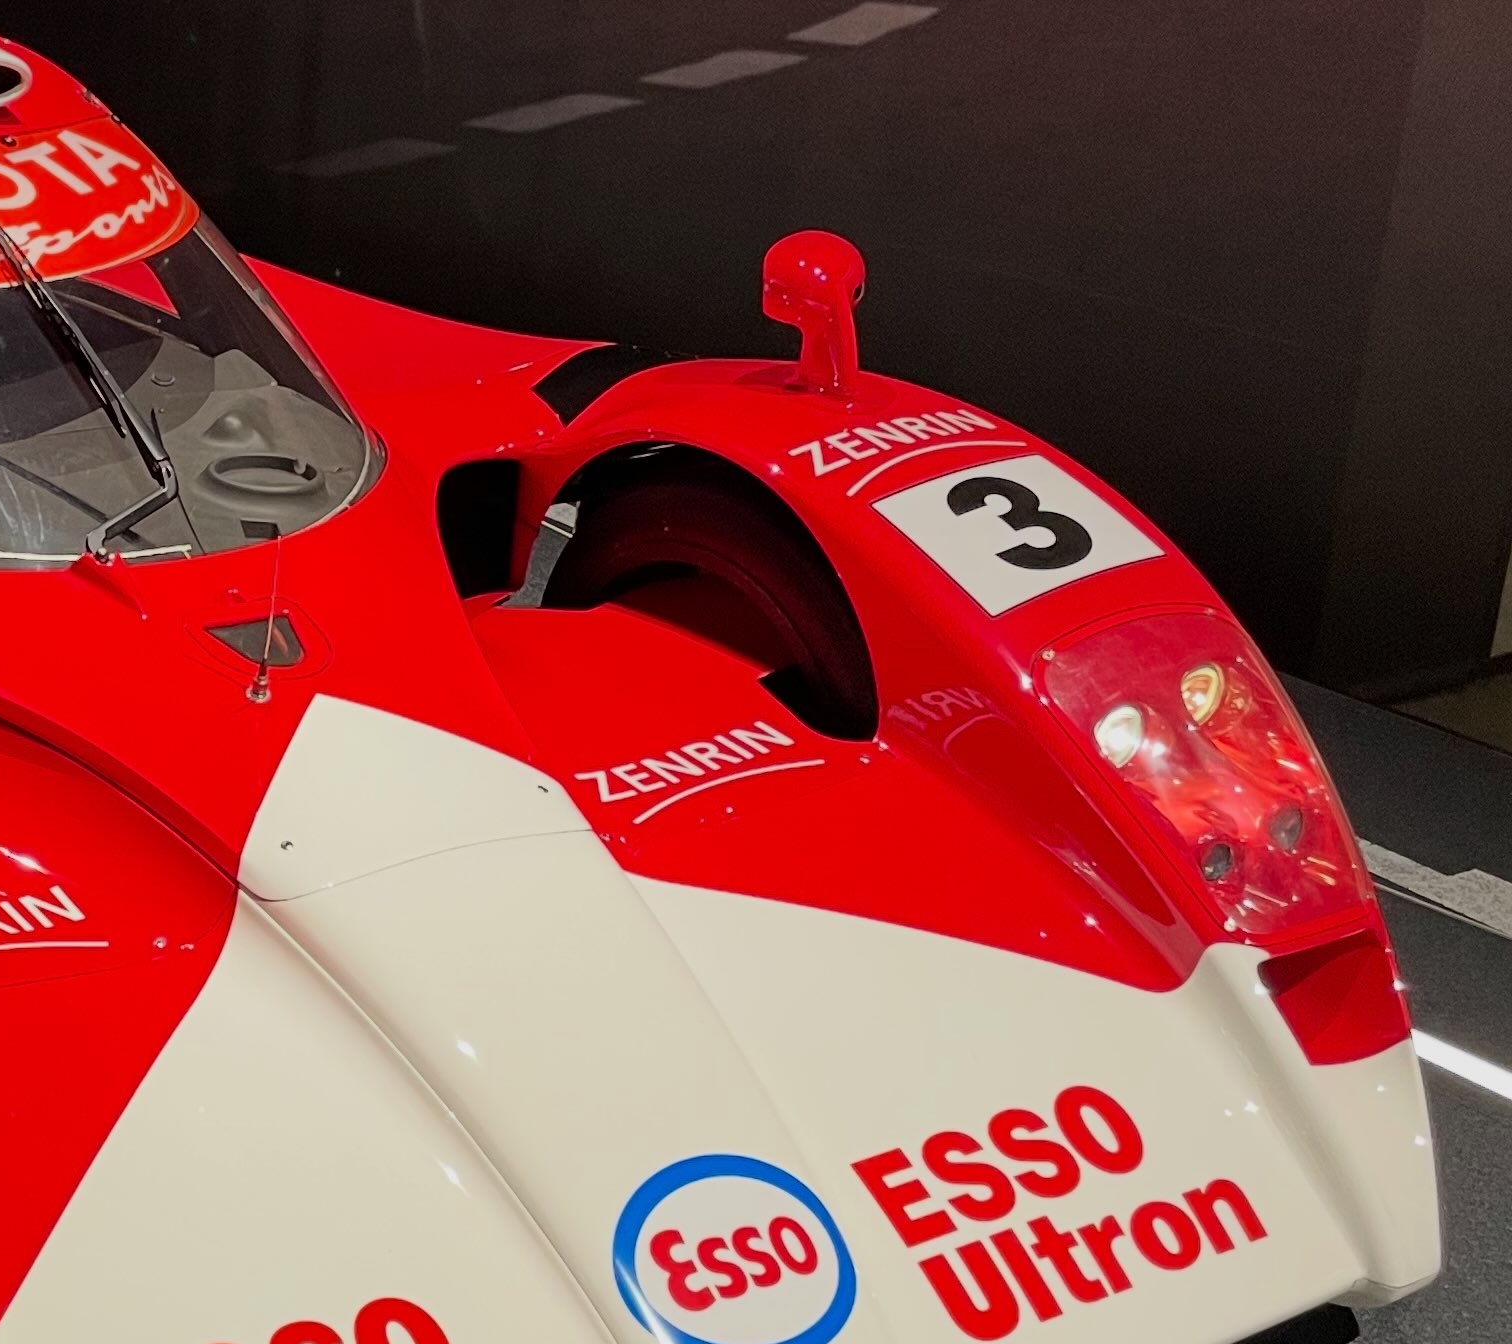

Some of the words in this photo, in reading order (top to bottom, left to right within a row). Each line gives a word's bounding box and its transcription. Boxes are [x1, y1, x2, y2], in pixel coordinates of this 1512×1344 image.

[788, 408, 998, 478] ZENRIN
[946, 476, 1093, 571] 3
[574, 720, 796, 803] ZENRIN
[850, 1084, 1145, 1249] ESSO
[918, 1177, 1268, 1343] Ultron
